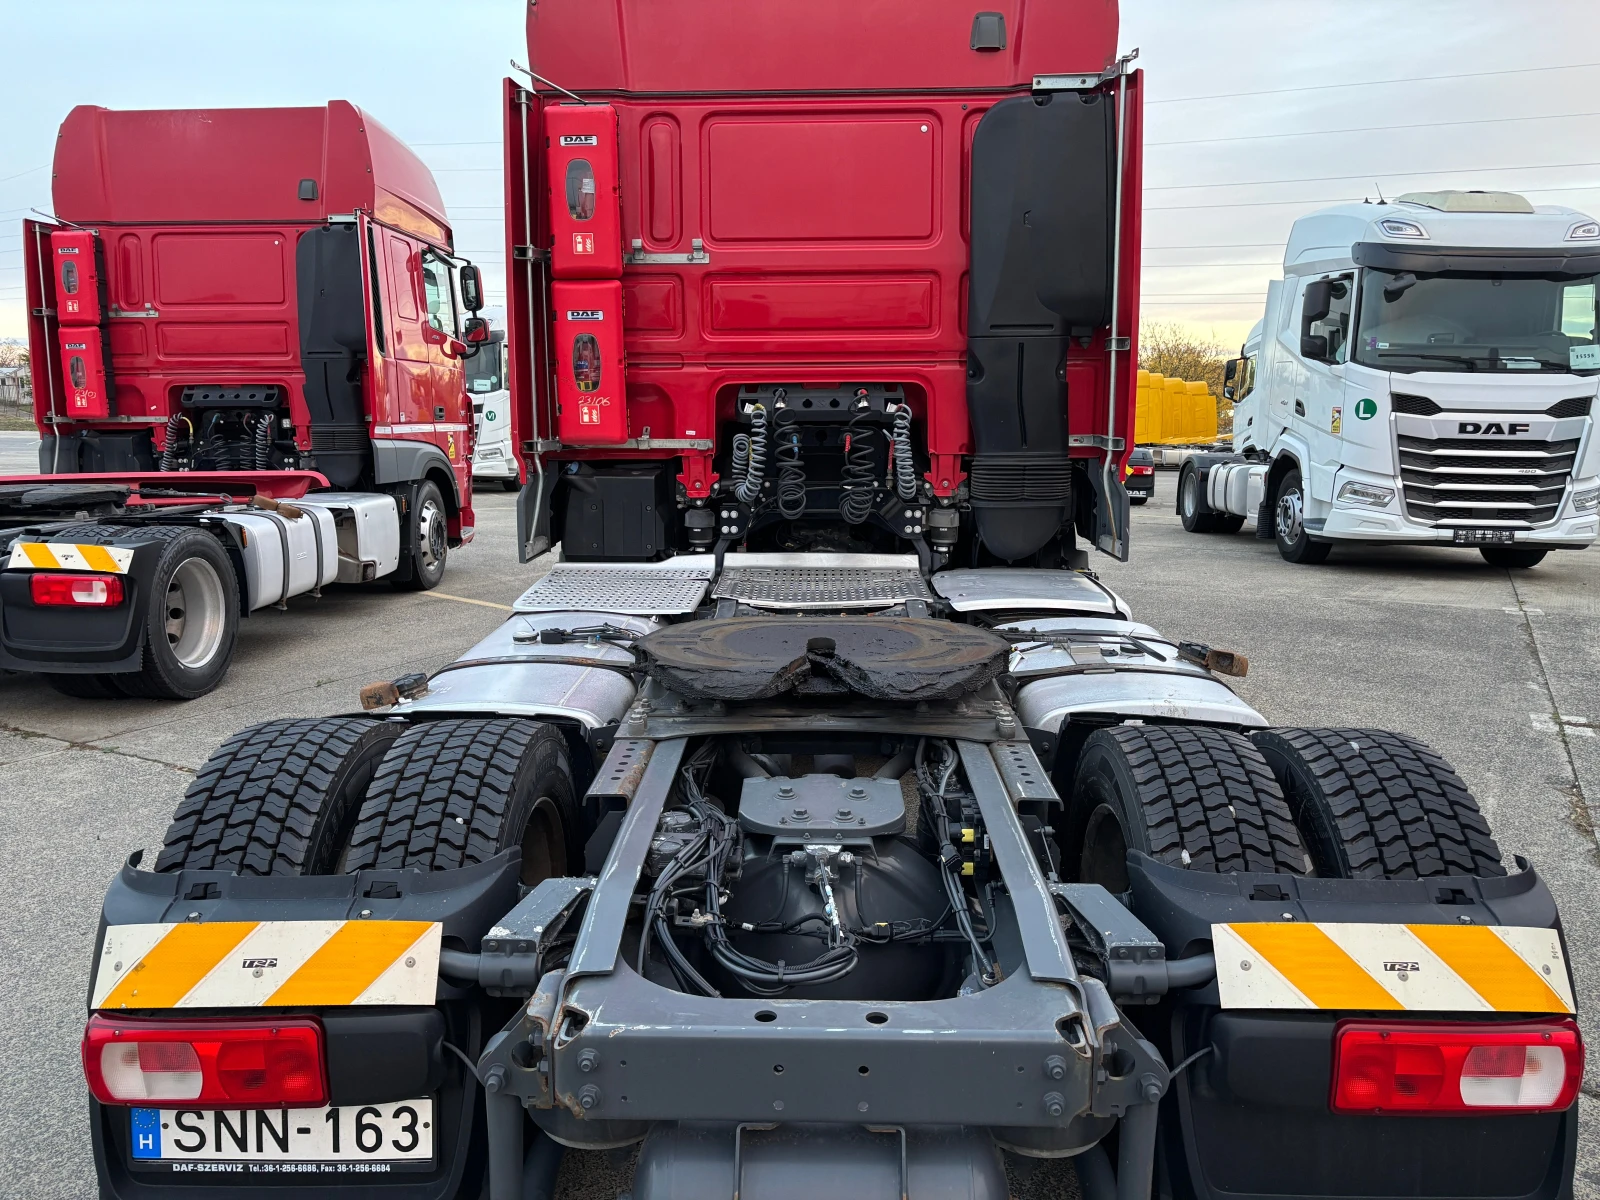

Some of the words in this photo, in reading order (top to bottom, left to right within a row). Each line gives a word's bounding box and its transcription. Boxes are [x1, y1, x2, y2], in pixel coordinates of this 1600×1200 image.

[564, 136, 593, 145] DAF
[571, 311, 600, 320] DAF
[1359, 401, 1372, 418] L
[1458, 422, 1530, 436] DAF
[243, 958, 277, 968] TRP
[1383, 962, 1420, 971] TRP
[173, 1105, 419, 1153] SNN-163
[139, 1133, 153, 1150] H
[172, 1163, 244, 1172] DAF-SZERVIZ
[321, 1164, 336, 1172] Fax:
